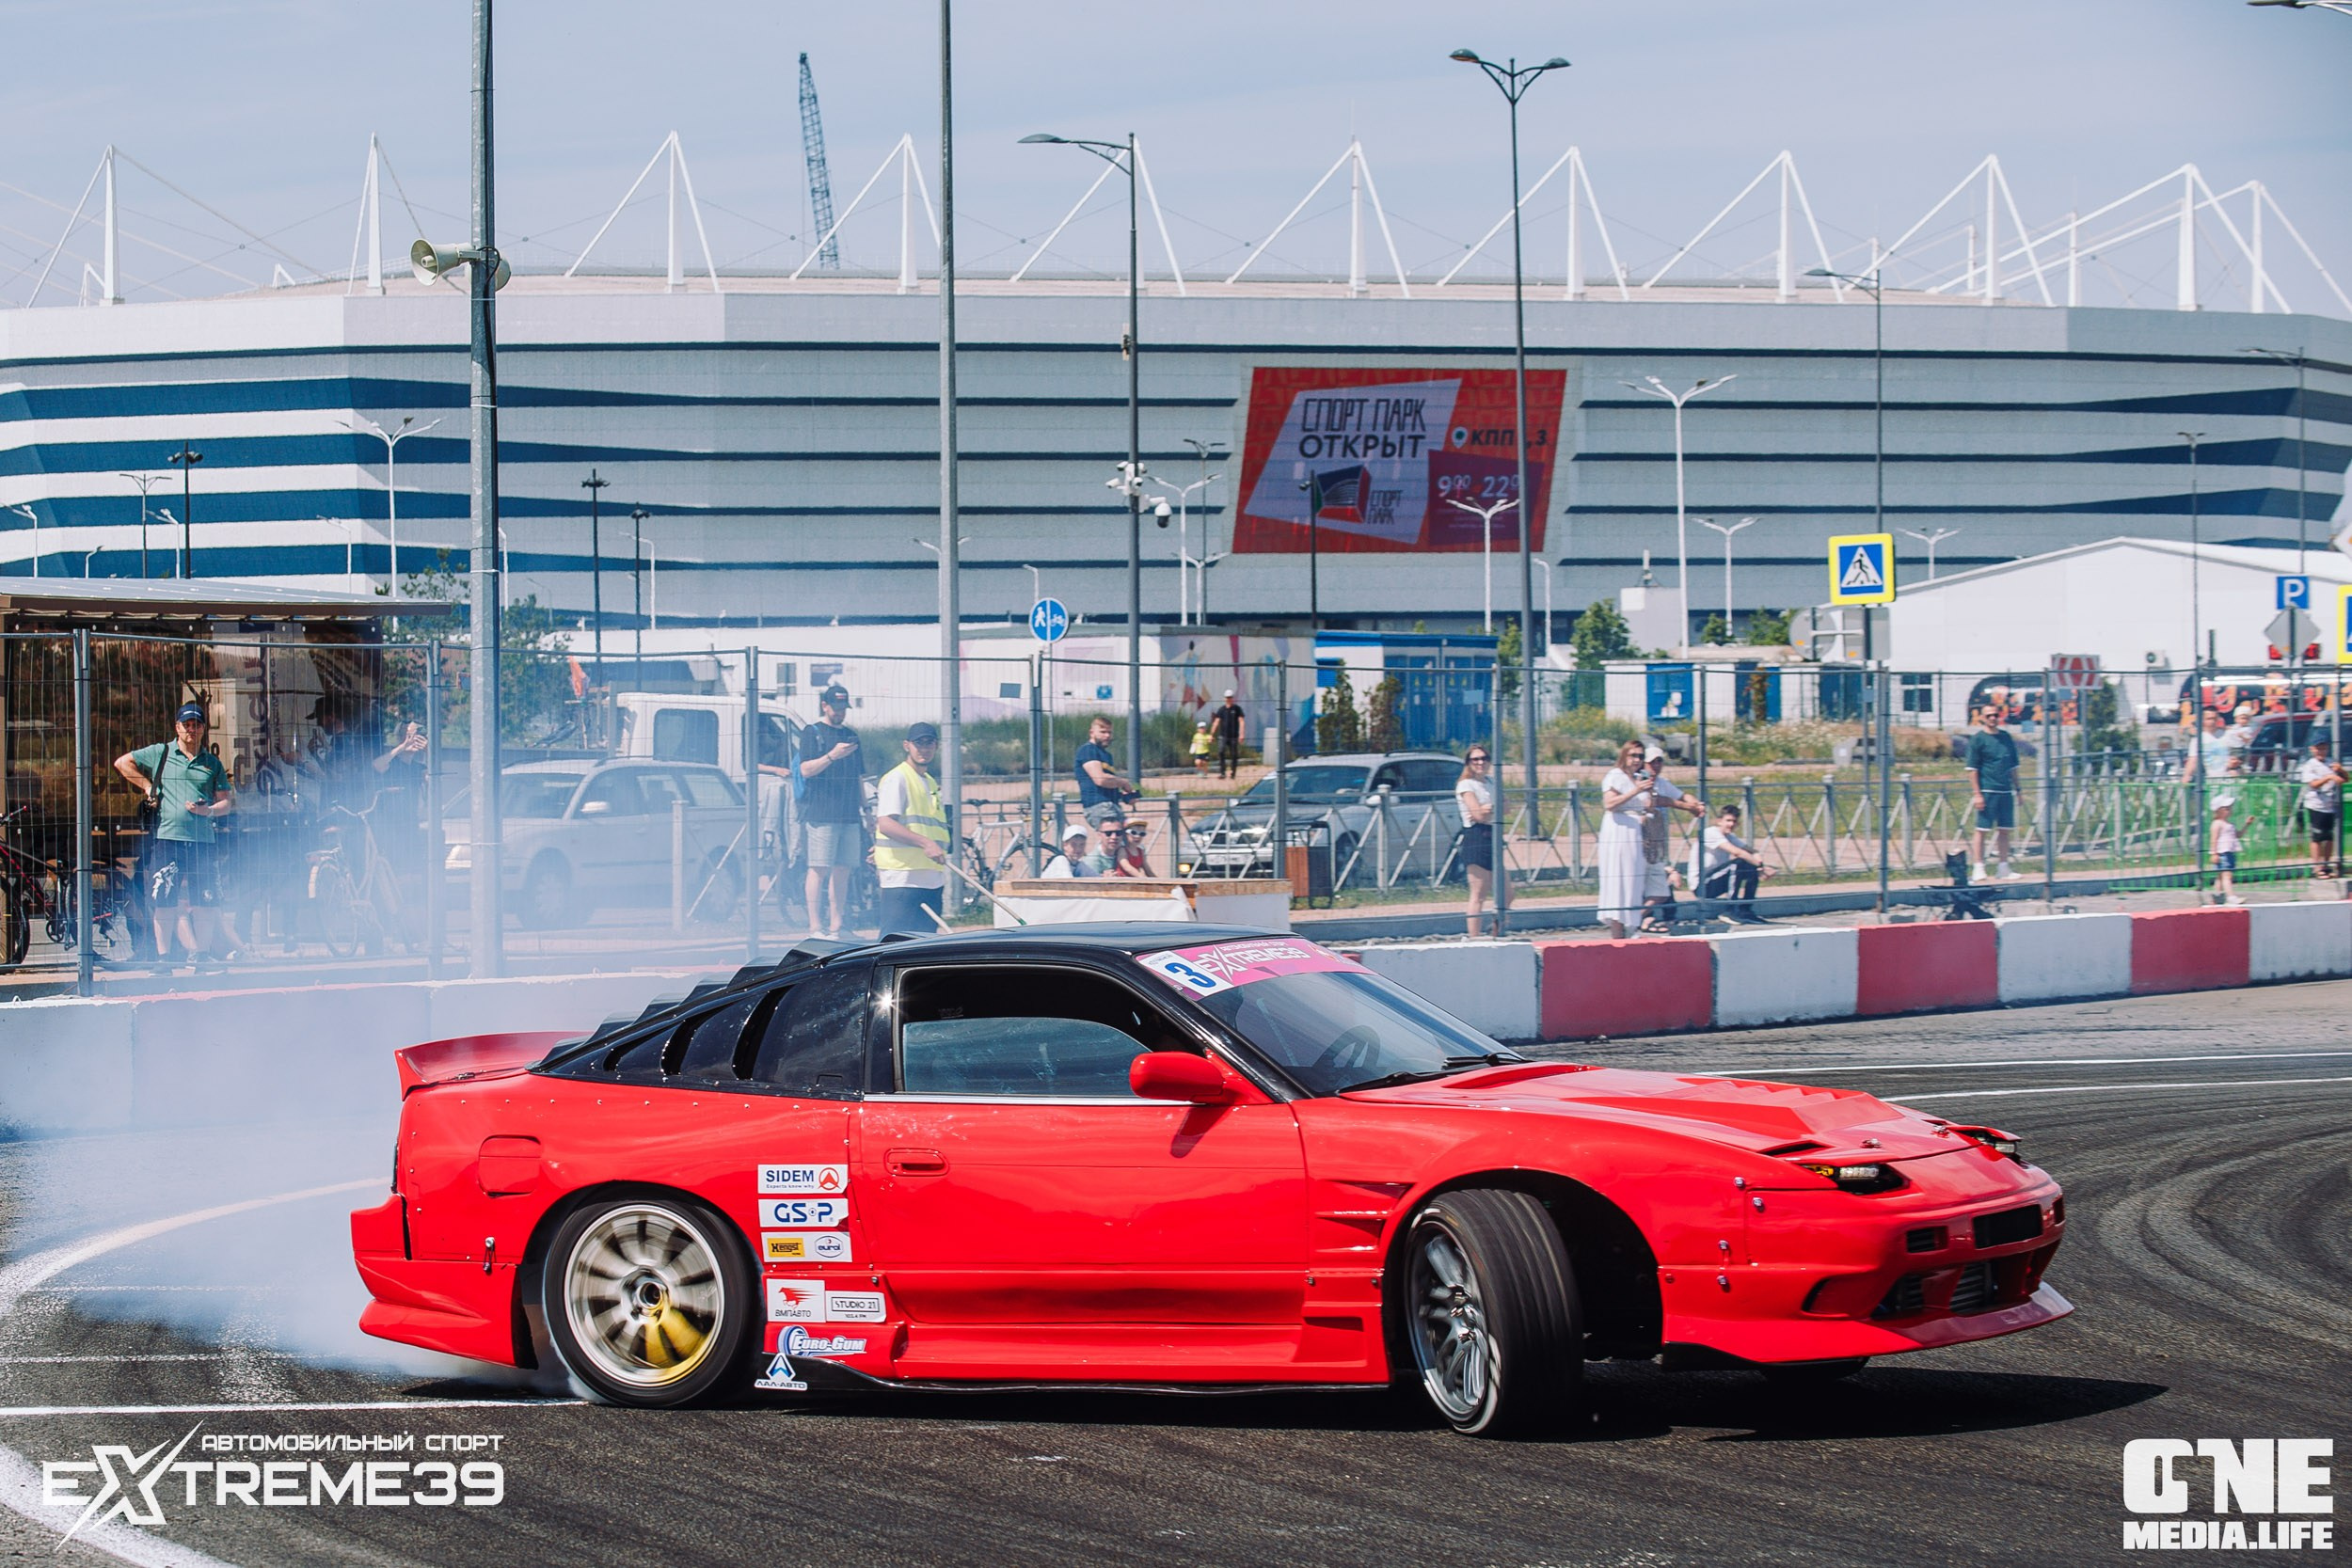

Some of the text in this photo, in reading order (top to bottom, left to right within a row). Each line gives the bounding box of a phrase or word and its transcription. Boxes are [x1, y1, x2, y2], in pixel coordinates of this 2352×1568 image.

[1302, 398, 1426, 432] СПОРТ ПАРК
[1299, 435, 1426, 459] ОТКРЫТ
[1471, 428, 1515, 446] КПП
[2283, 578, 2305, 608] P
[1165, 962, 1216, 988] 3
[766, 1169, 815, 1182] SIDEM
[834, 1300, 877, 1309] STUDIO 21
